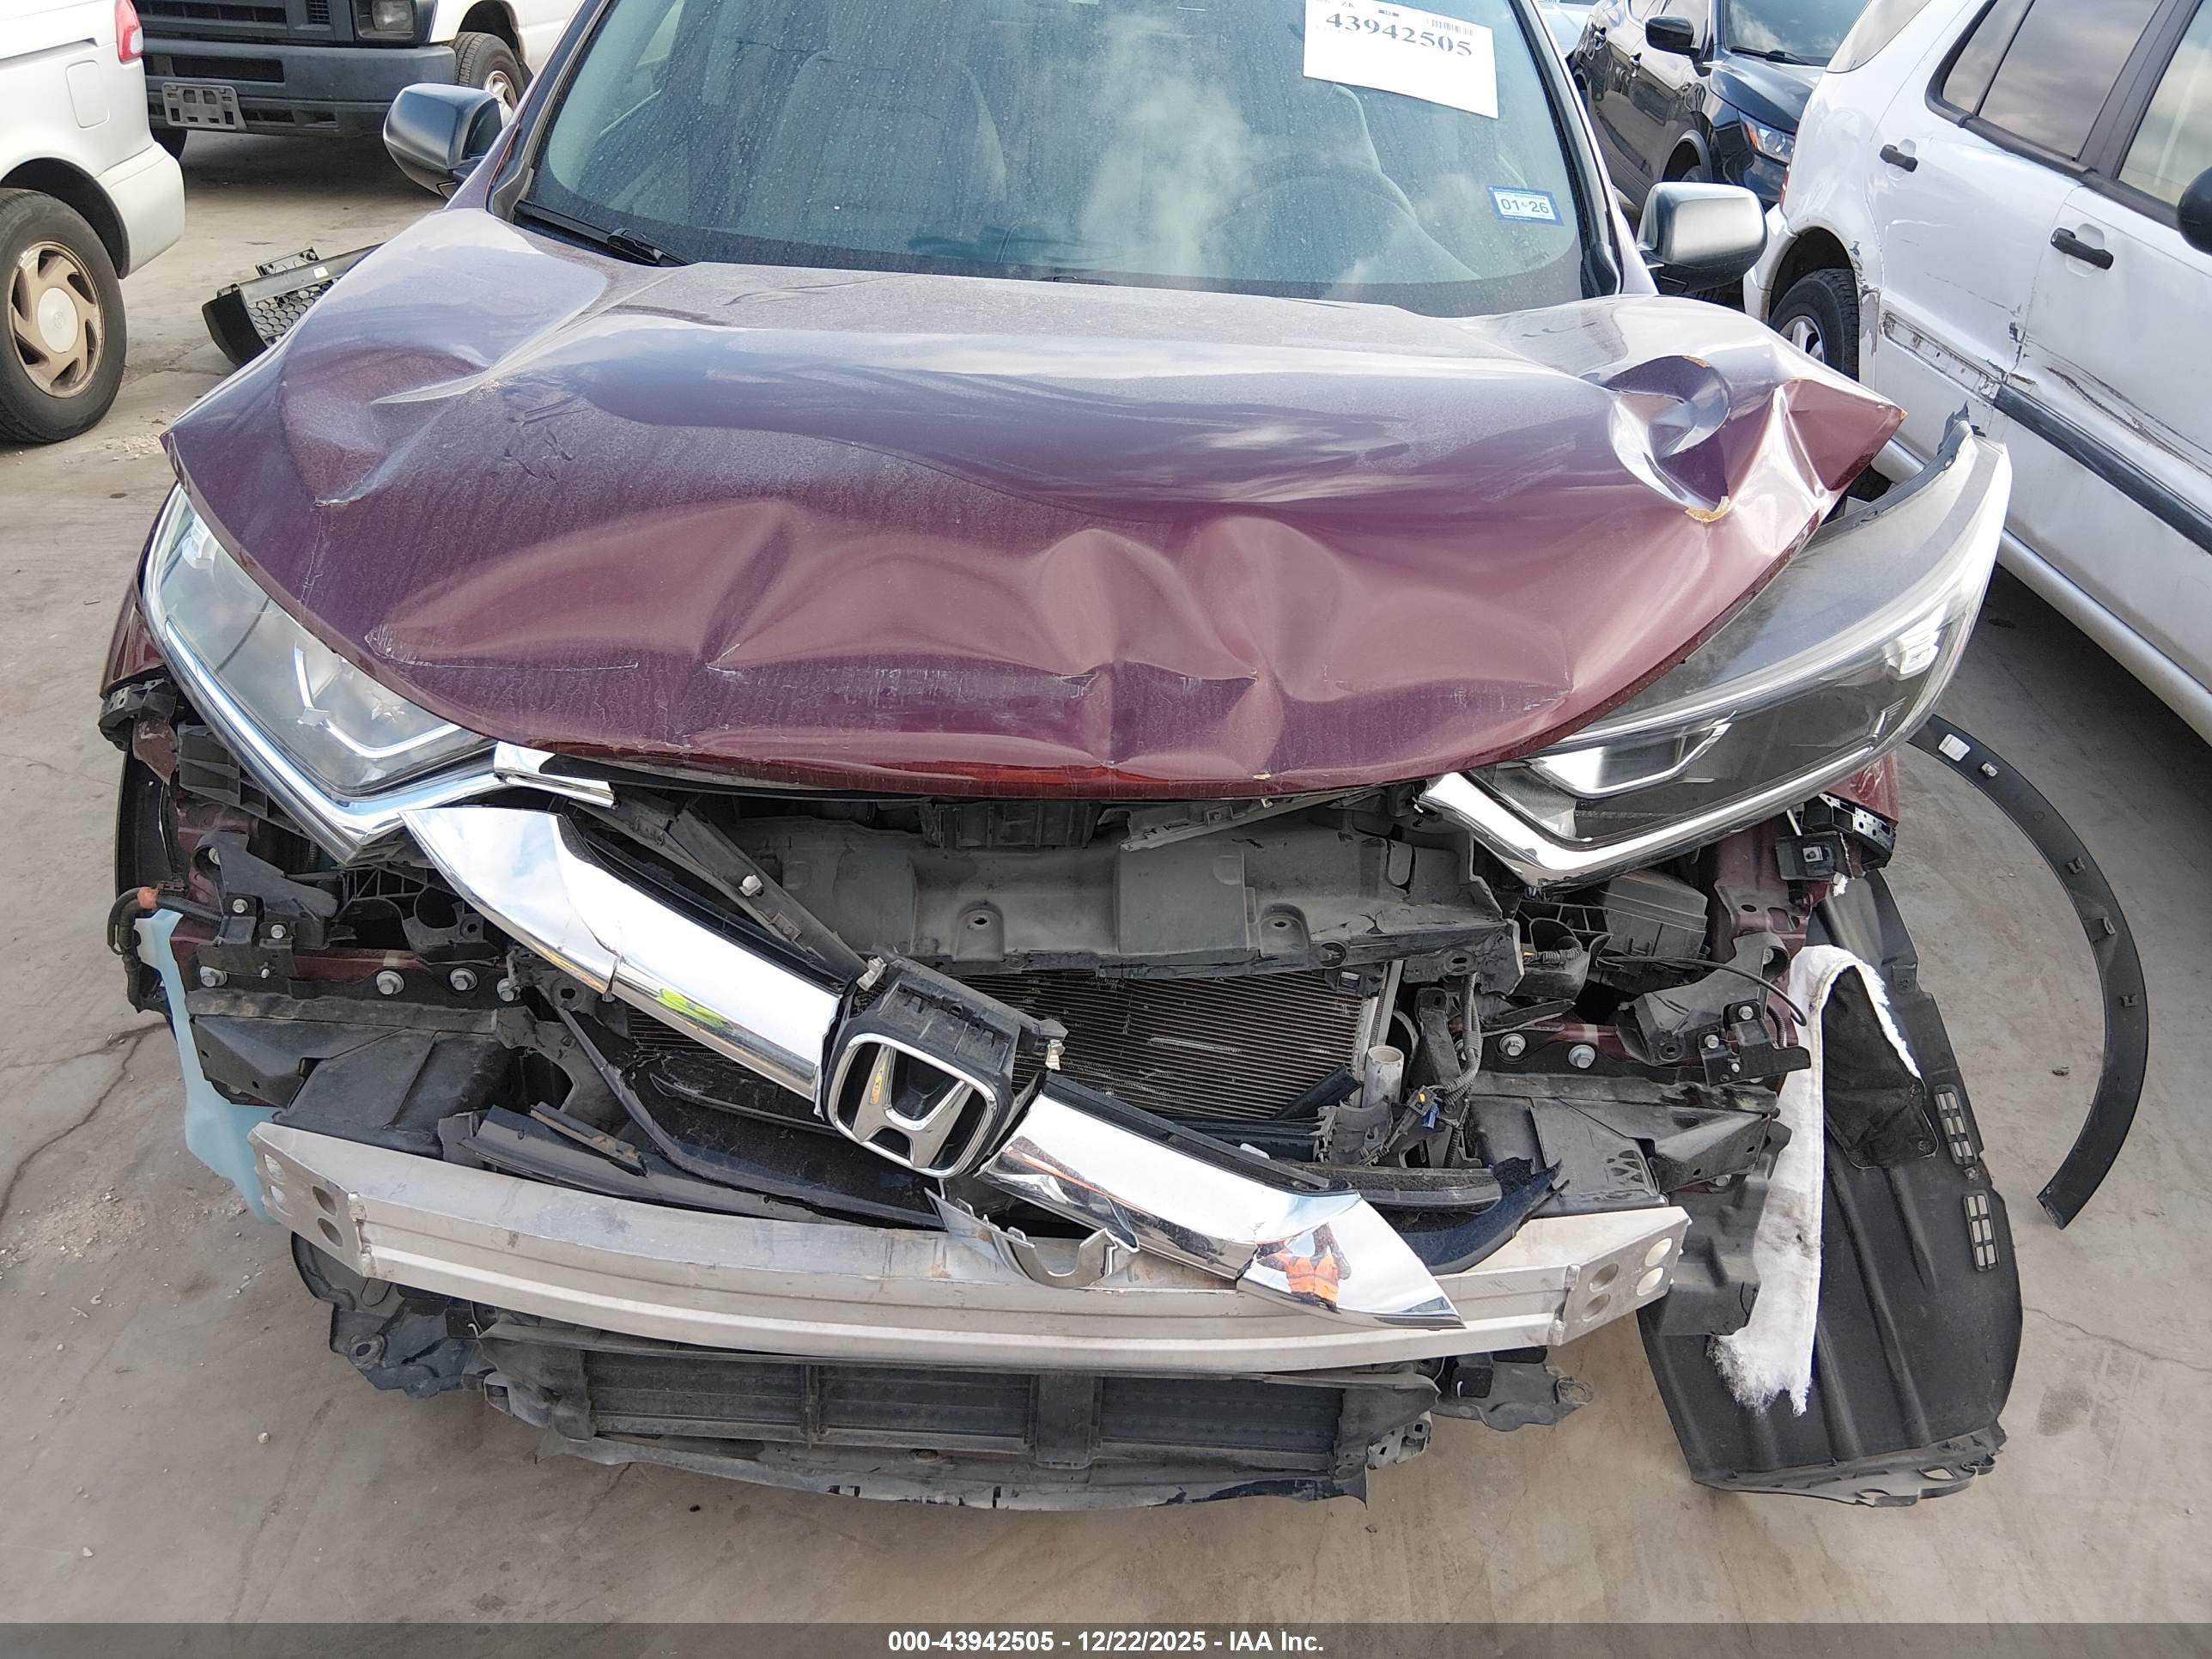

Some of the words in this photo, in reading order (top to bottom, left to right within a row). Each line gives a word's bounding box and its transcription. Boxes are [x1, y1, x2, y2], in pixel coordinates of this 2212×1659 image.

[1325, 13, 1473, 57] 43942505
[1500, 198, 1520, 211] 01
[1528, 200, 1549, 214] 26
